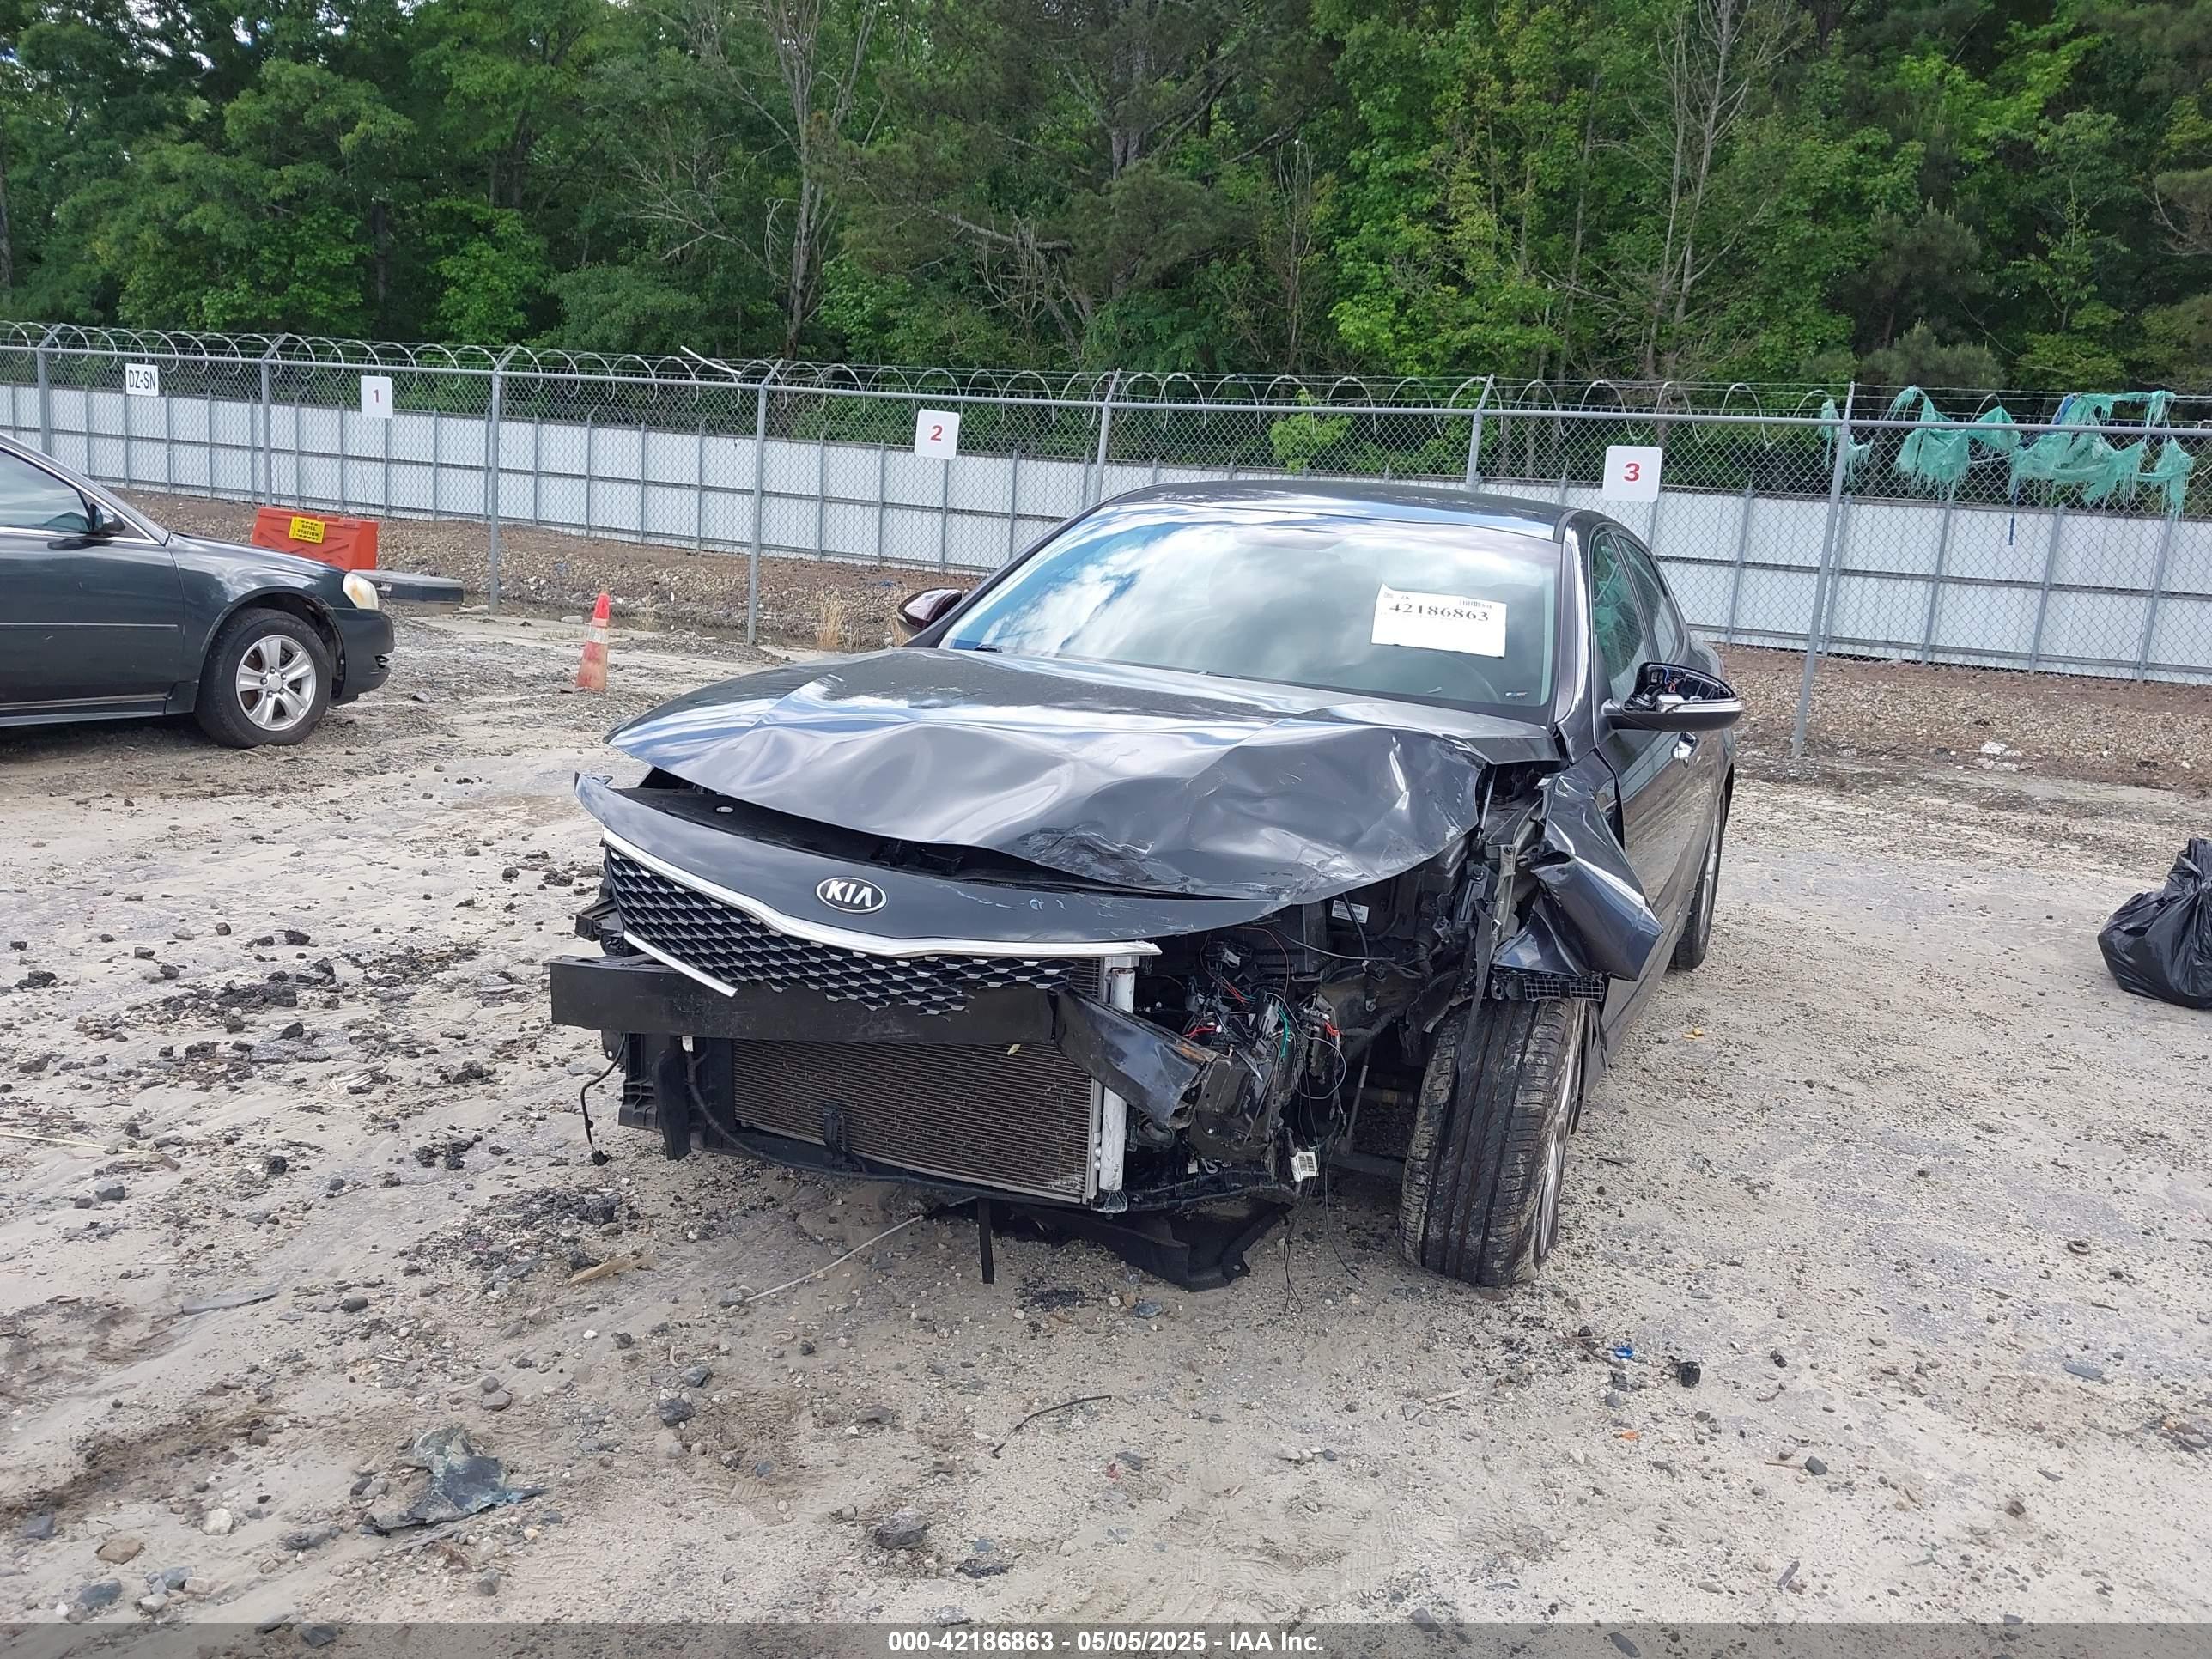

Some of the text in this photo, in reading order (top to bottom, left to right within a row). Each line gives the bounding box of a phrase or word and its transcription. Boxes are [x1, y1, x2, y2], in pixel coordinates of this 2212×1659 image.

[129, 369, 156, 390] DZ-SN
[373, 388, 380, 404] 1
[930, 424, 943, 441] 2
[1623, 462, 1640, 482] 3
[1389, 603, 1489, 622] 42186863
[825, 880, 872, 908] KIA
